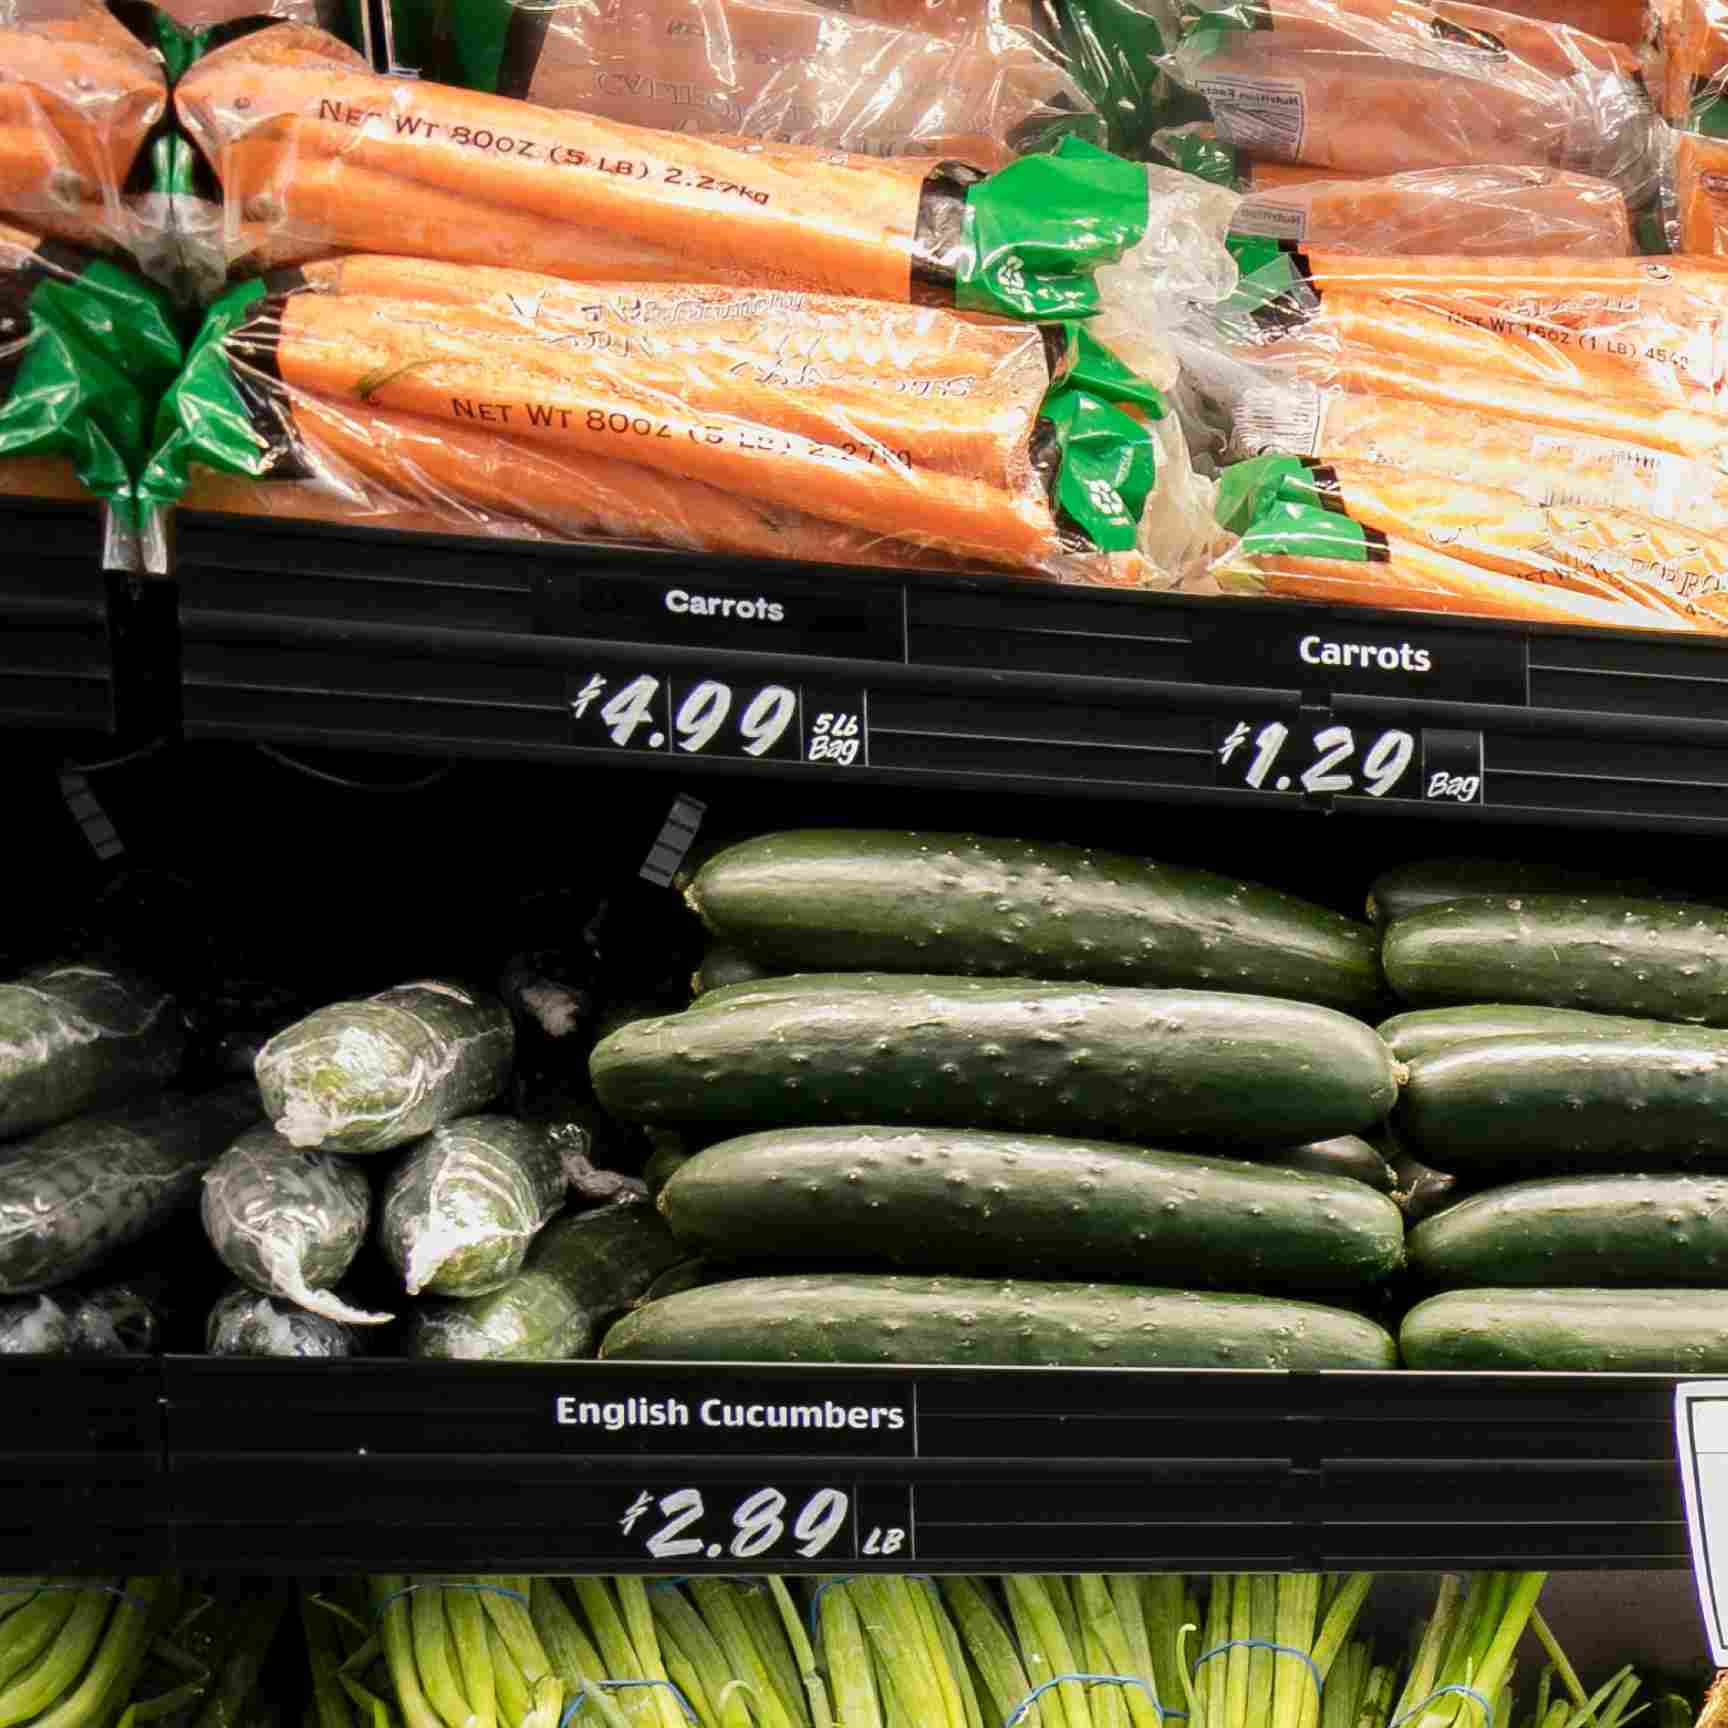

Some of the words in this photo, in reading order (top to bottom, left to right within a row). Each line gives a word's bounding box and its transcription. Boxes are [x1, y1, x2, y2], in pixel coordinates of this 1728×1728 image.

[394, 112, 440, 139] WT
[549, 143, 588, 167] (5
[598, 153, 650, 180] LB)
[663, 166, 770, 206] 2.27kg
[451, 397, 513, 424] NET
[525, 402, 573, 430] WT
[665, 590, 784, 621] Carrots
[1300, 636, 1431, 671] Carrots
[571, 674, 796, 756] $4.99
[1218, 722, 1414, 796] $1.29
[1427, 765, 1484, 805] Bag
[558, 1397, 688, 1430] English
[701, 1399, 904, 1429] Cucumbers
[620, 1488, 848, 1558] $2.89
